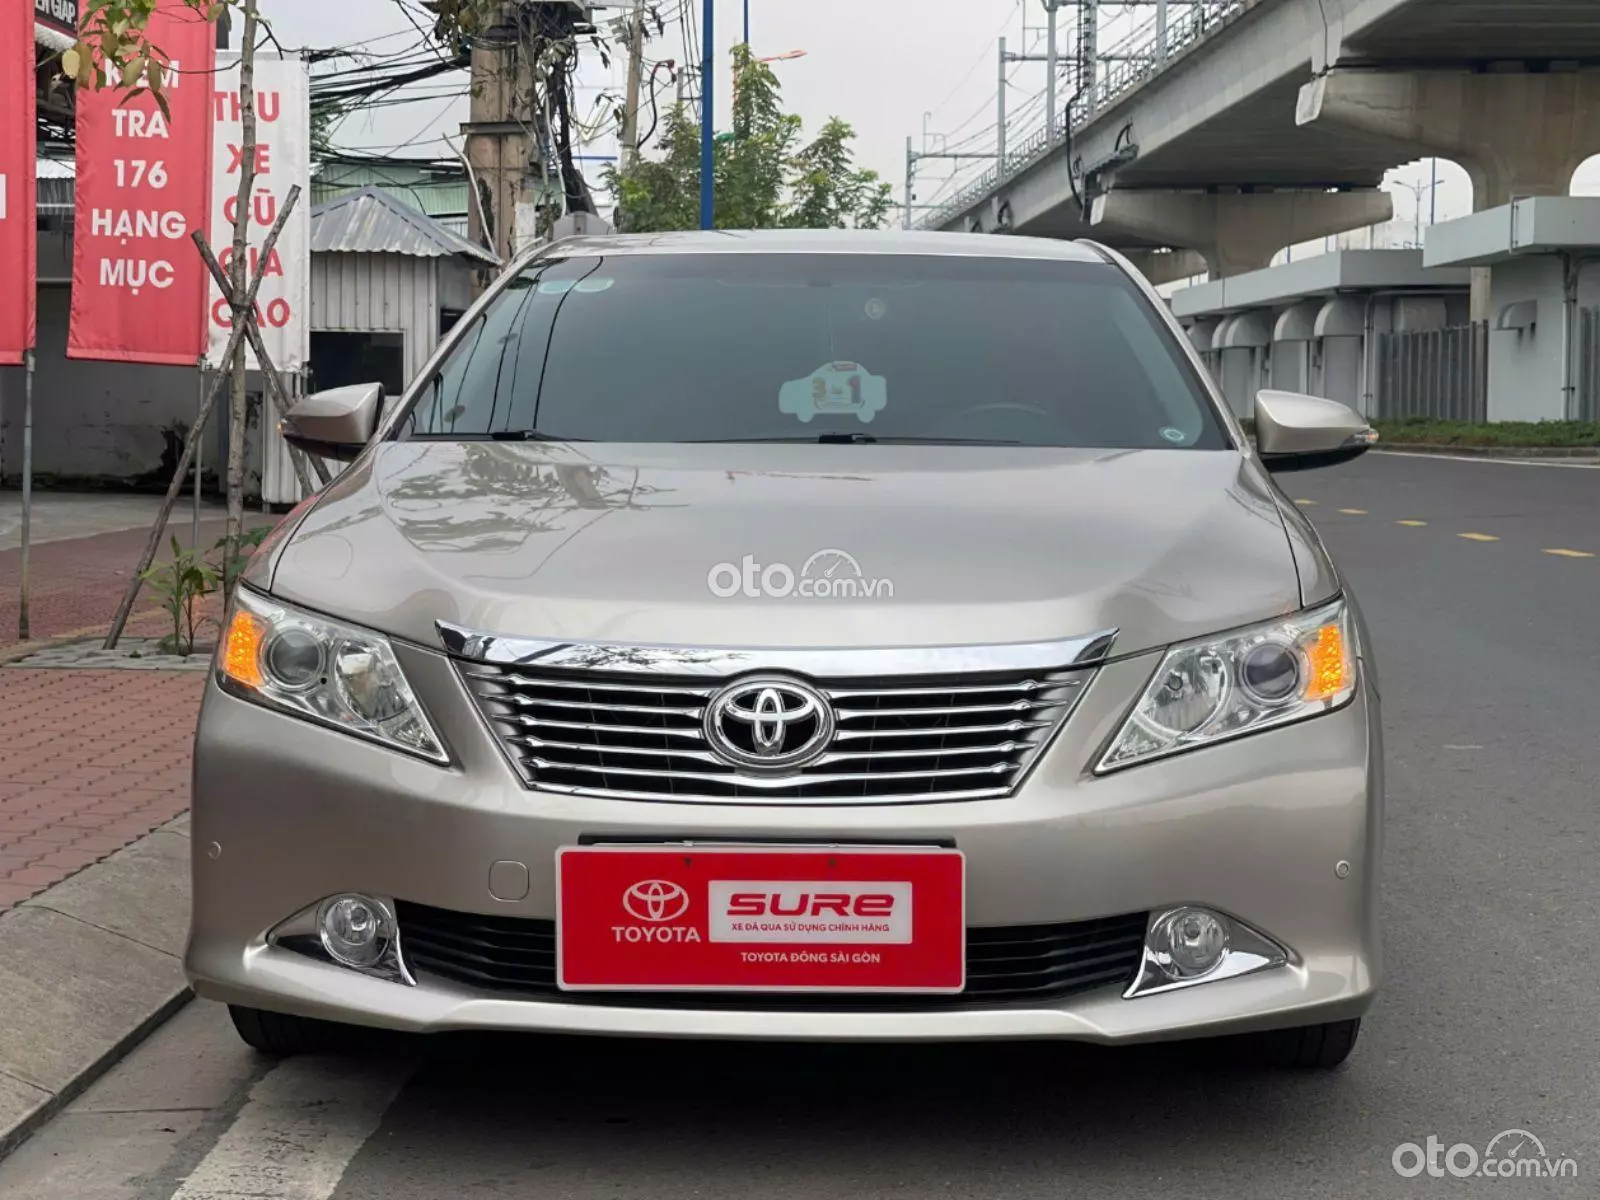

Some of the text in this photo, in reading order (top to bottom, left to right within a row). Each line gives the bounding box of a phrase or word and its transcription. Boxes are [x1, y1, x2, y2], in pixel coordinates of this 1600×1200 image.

[104, 58, 180, 89] KM
[213, 92, 280, 123] THU
[111, 108, 169, 139] TRA
[113, 159, 168, 189] 176
[226, 143, 270, 174] XE
[91, 208, 188, 245] HẠNG
[99, 257, 175, 295] MỤC
[611, 926, 701, 943] TOYOTA
[731, 922, 743, 932] XE
[760, 922, 782, 932] QUA
[798, 922, 827, 934] DỤNG
[829, 920, 860, 932] CHÍNH
[741, 950, 881, 964] TOYOTA ĐÔNG SÀI GÒN
